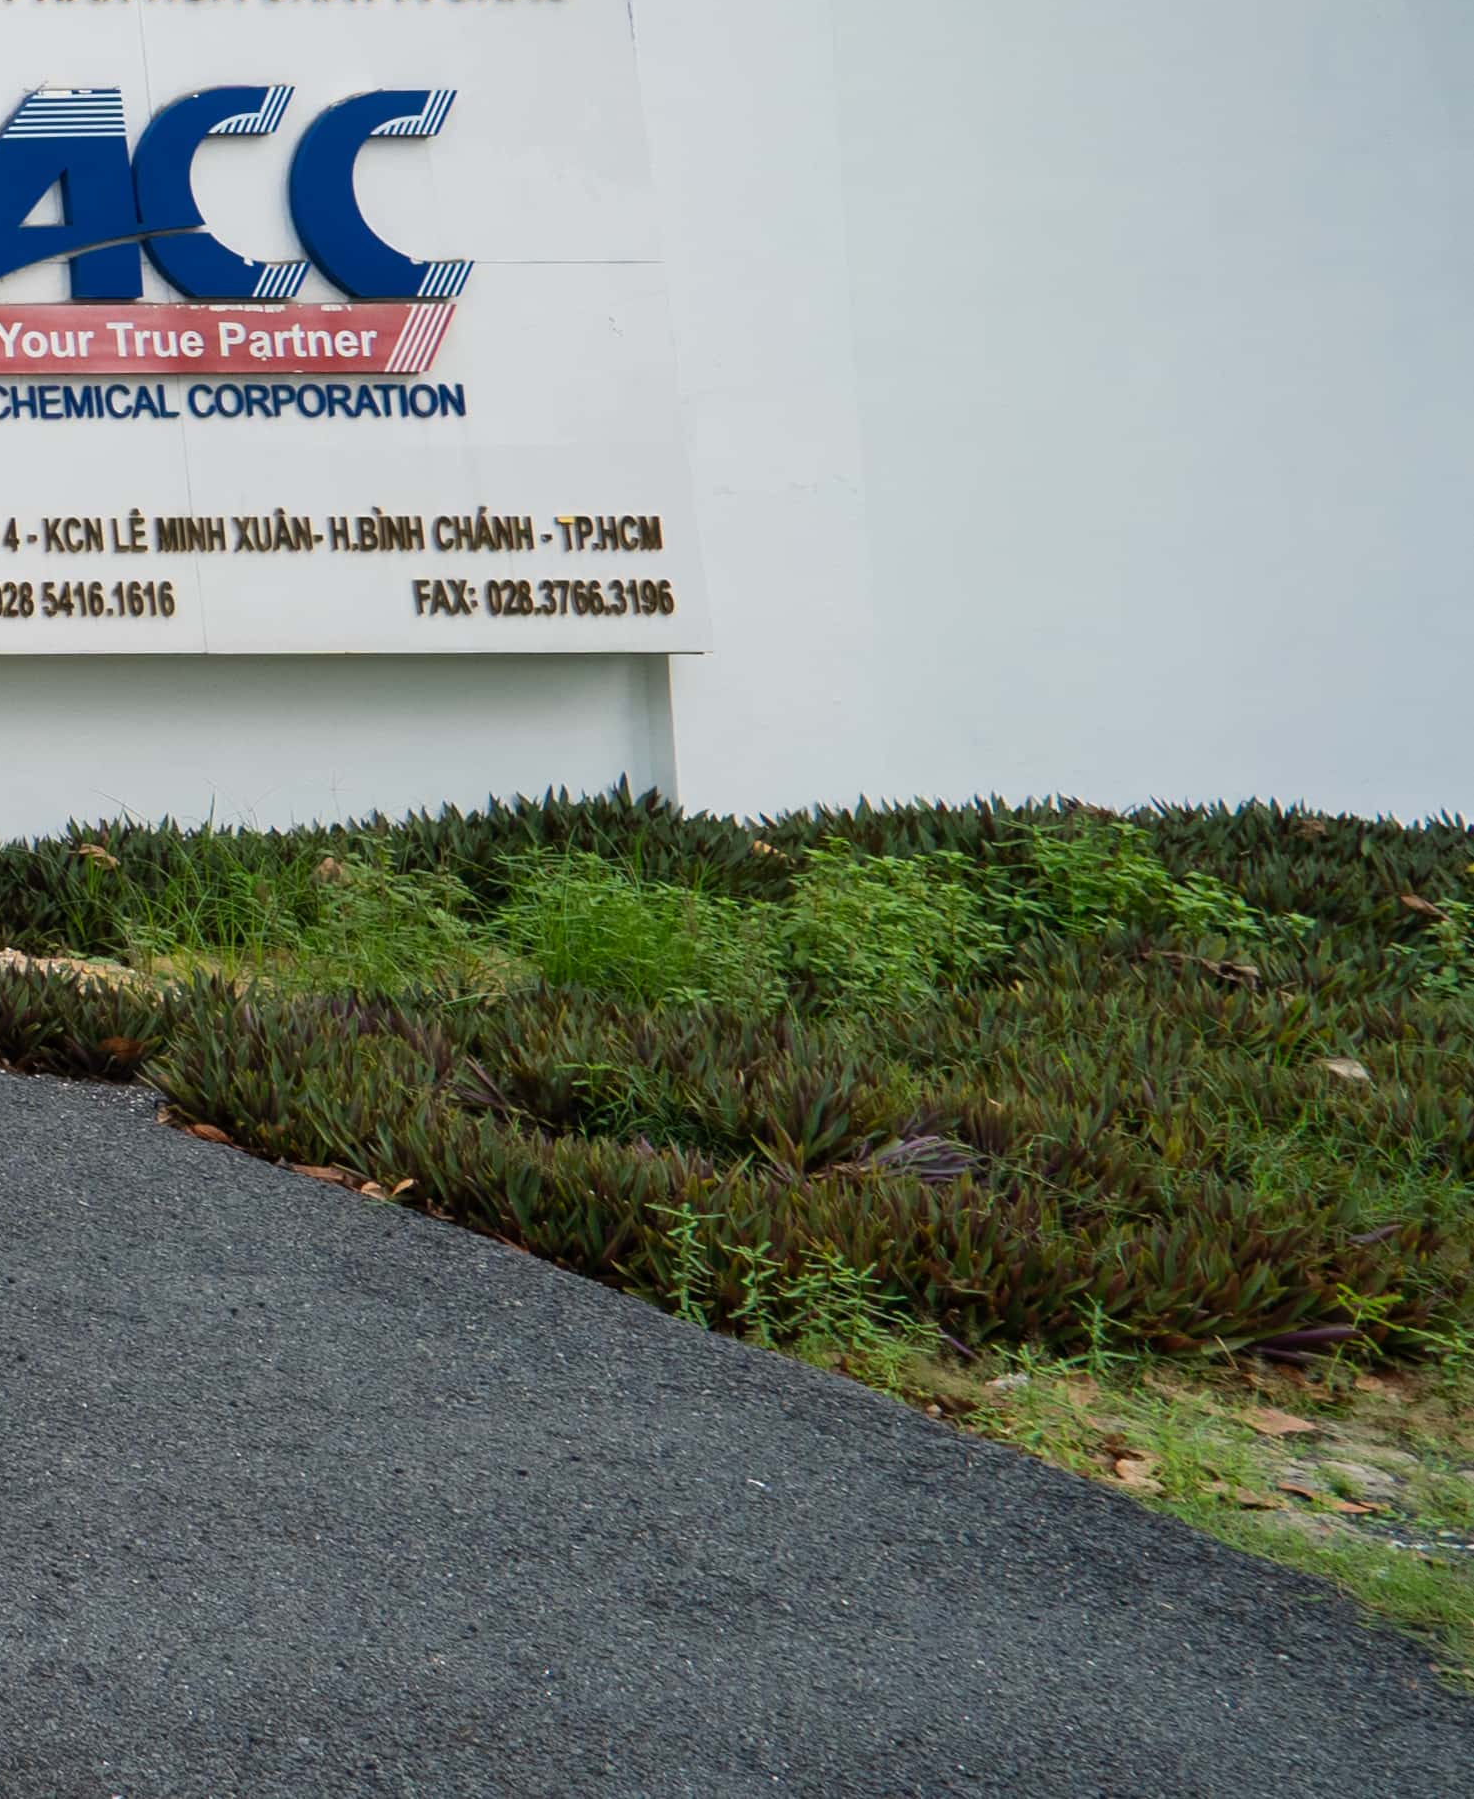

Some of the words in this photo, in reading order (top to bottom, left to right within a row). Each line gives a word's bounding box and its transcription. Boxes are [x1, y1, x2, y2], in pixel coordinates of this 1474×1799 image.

[106, 320, 205, 358] True
[220, 320, 378, 360] Partner
[188, 384, 466, 418] CORPORATION
[2, 517, 21, 553] 4
[43, 517, 105, 553] KCN
[111, 508, 148, 553] LÊ
[156, 516, 226, 553] MINH
[431, 506, 536, 553] CHÁNH
[554, 516, 664, 552] TP.HCM
[41, 580, 175, 618] 5416.1616
[411, 578, 477, 616] FAX:
[485, 578, 675, 616] 028.3766.3196
